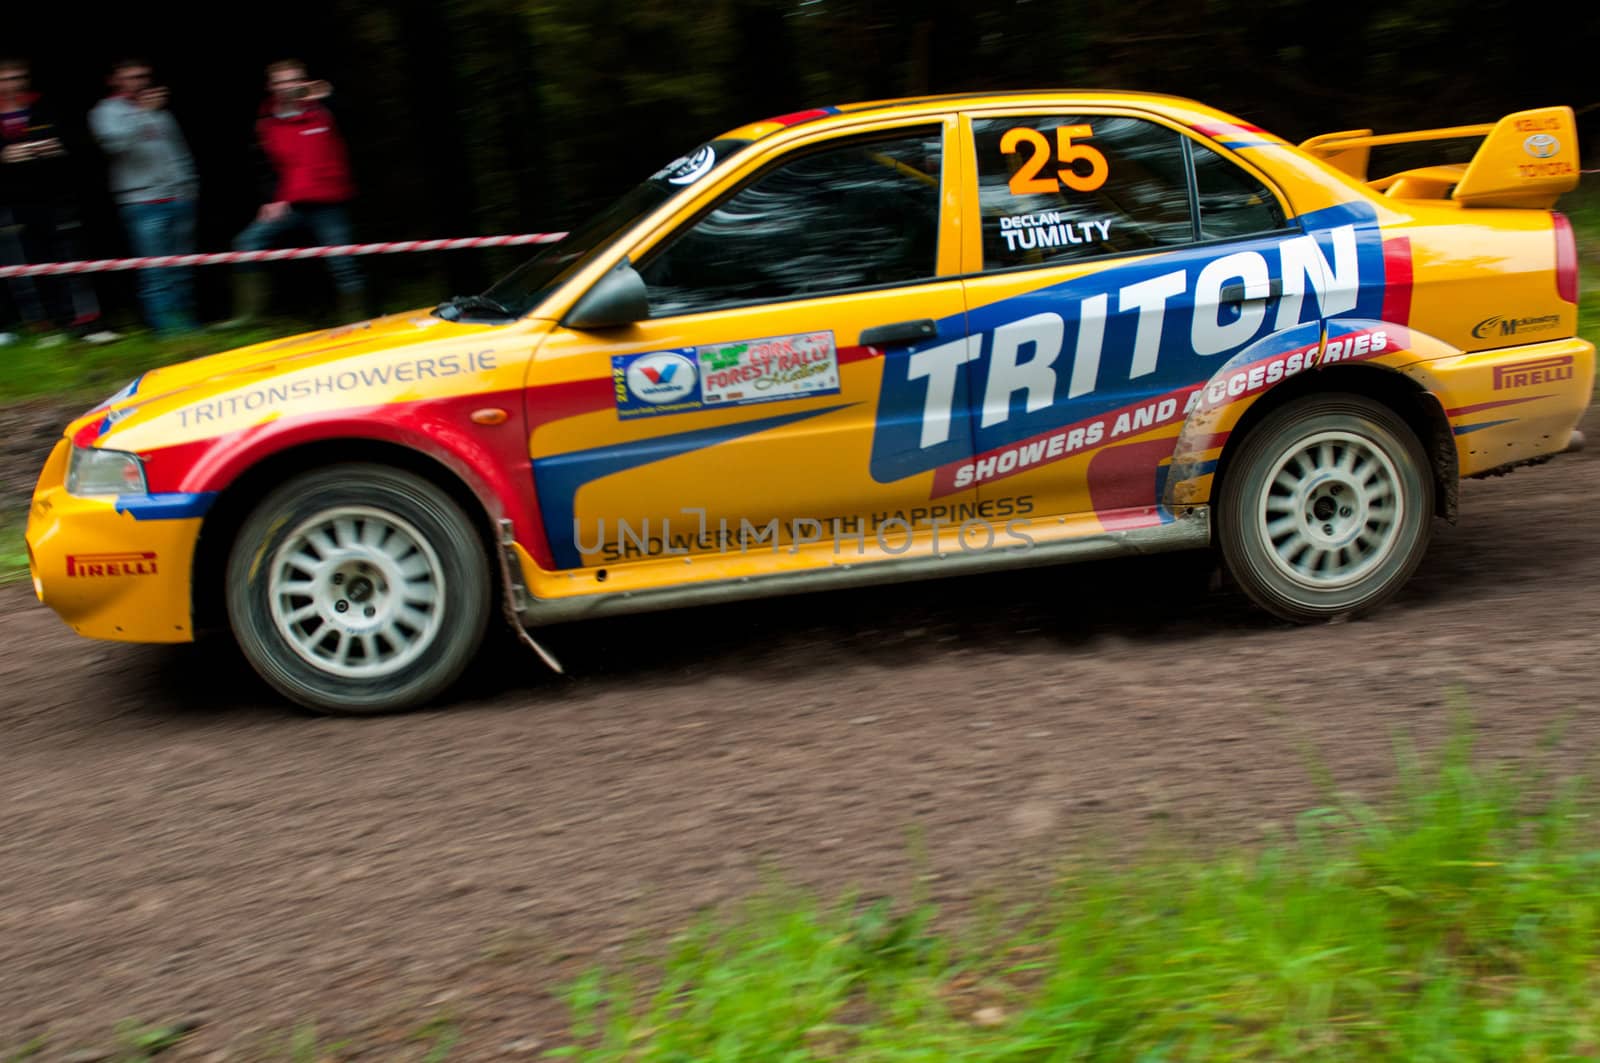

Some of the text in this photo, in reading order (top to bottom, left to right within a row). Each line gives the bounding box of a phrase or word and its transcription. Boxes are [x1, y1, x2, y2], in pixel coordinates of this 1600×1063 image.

[1000, 123, 1109, 195] 25
[1000, 211, 1061, 229] DECLAN
[1000, 219, 1112, 251] TUMILTY
[907, 224, 1359, 450] TRITON
[705, 358, 773, 391] FOREST
[779, 343, 830, 371] RALLY
[1492, 355, 1574, 391] PIRELLI
[175, 349, 498, 428] TRITONSHOWERS.IE
[954, 331, 1388, 488] SHOWERS AND ACCESSORIES
[871, 495, 1035, 530] HAPPINESS
[66, 551, 158, 577] PIRELLI
